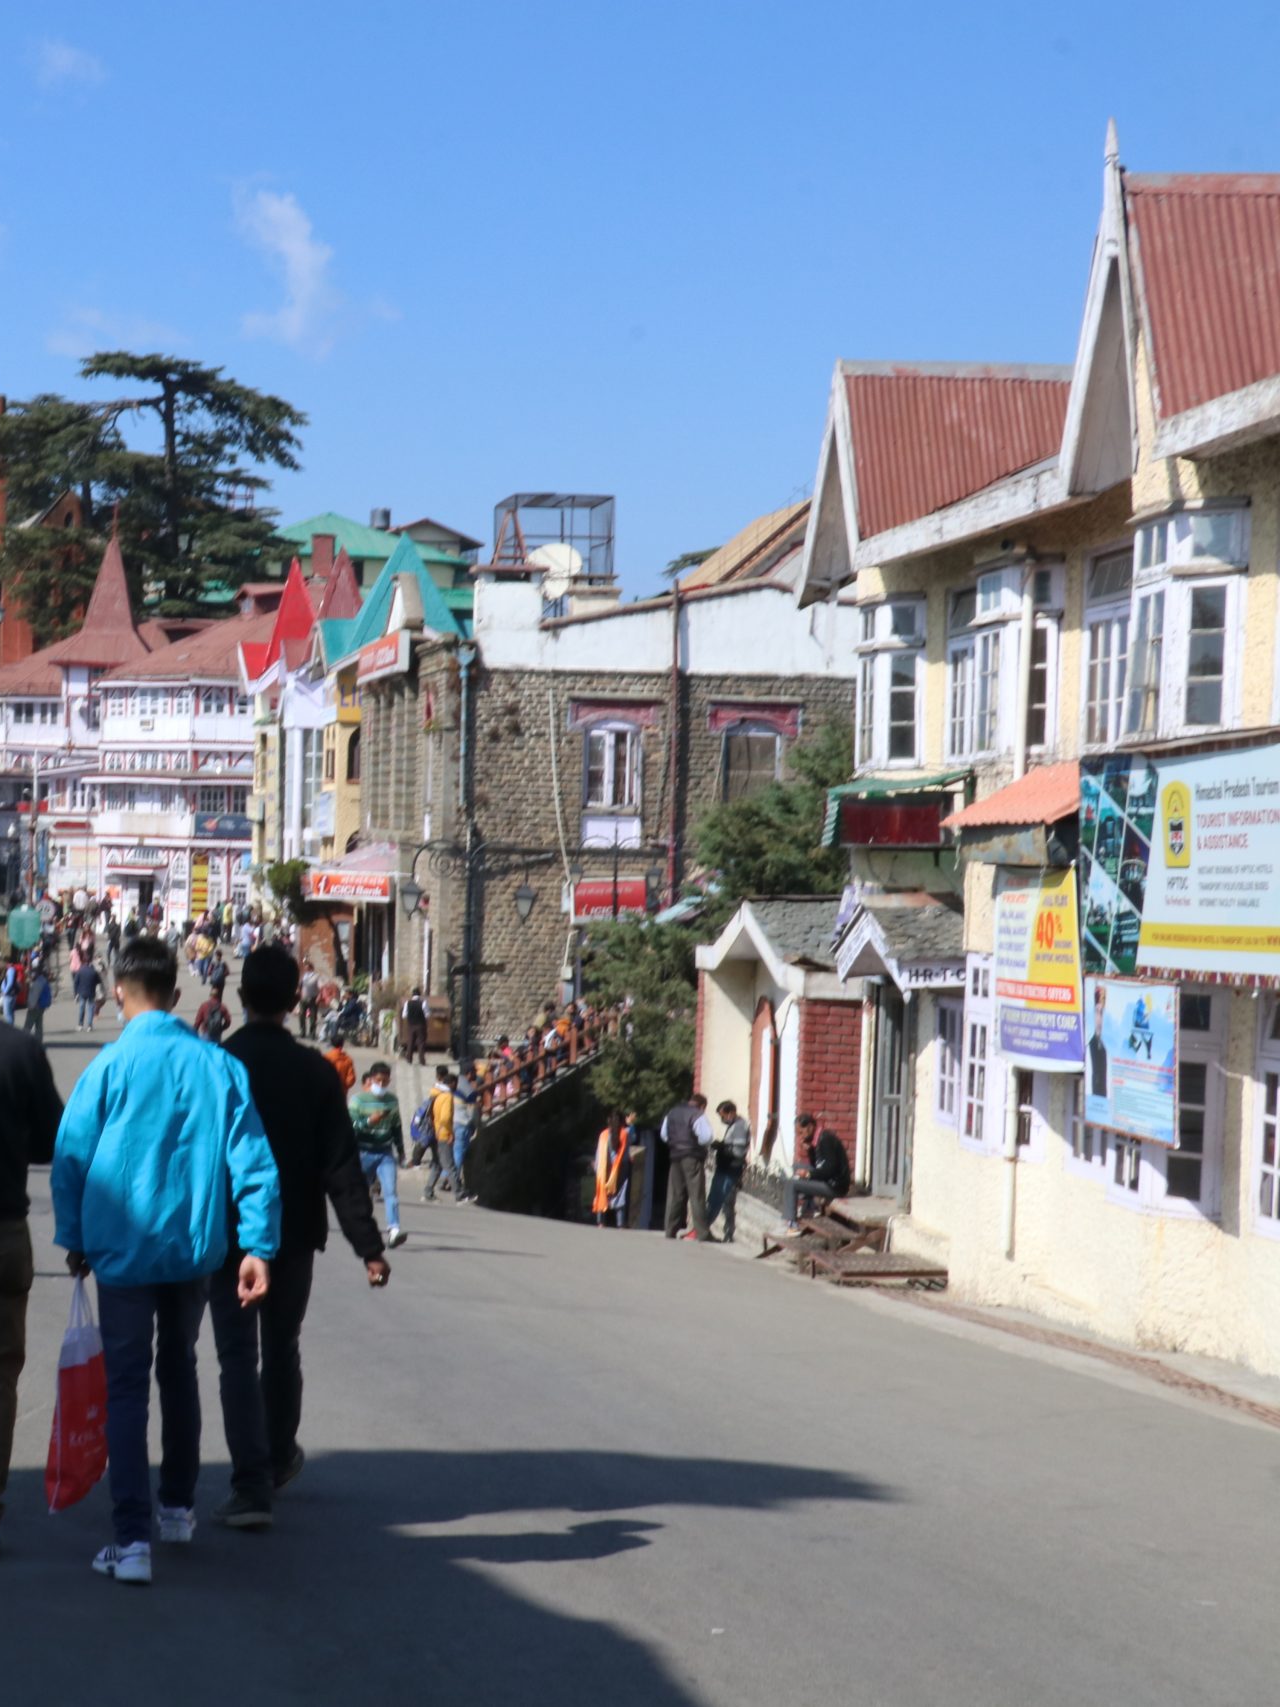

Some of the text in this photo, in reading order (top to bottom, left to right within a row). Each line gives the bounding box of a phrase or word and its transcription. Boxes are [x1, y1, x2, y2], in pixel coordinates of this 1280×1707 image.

[340, 686, 362, 707] LI
[1195, 777, 1279, 801] Himachal Pradesh Tourism
[1197, 808, 1280, 829] TOURIST INFORMATION
[1204, 832, 1248, 850] ASSISTANCE
[330, 884, 382, 897] ICICI Bank
